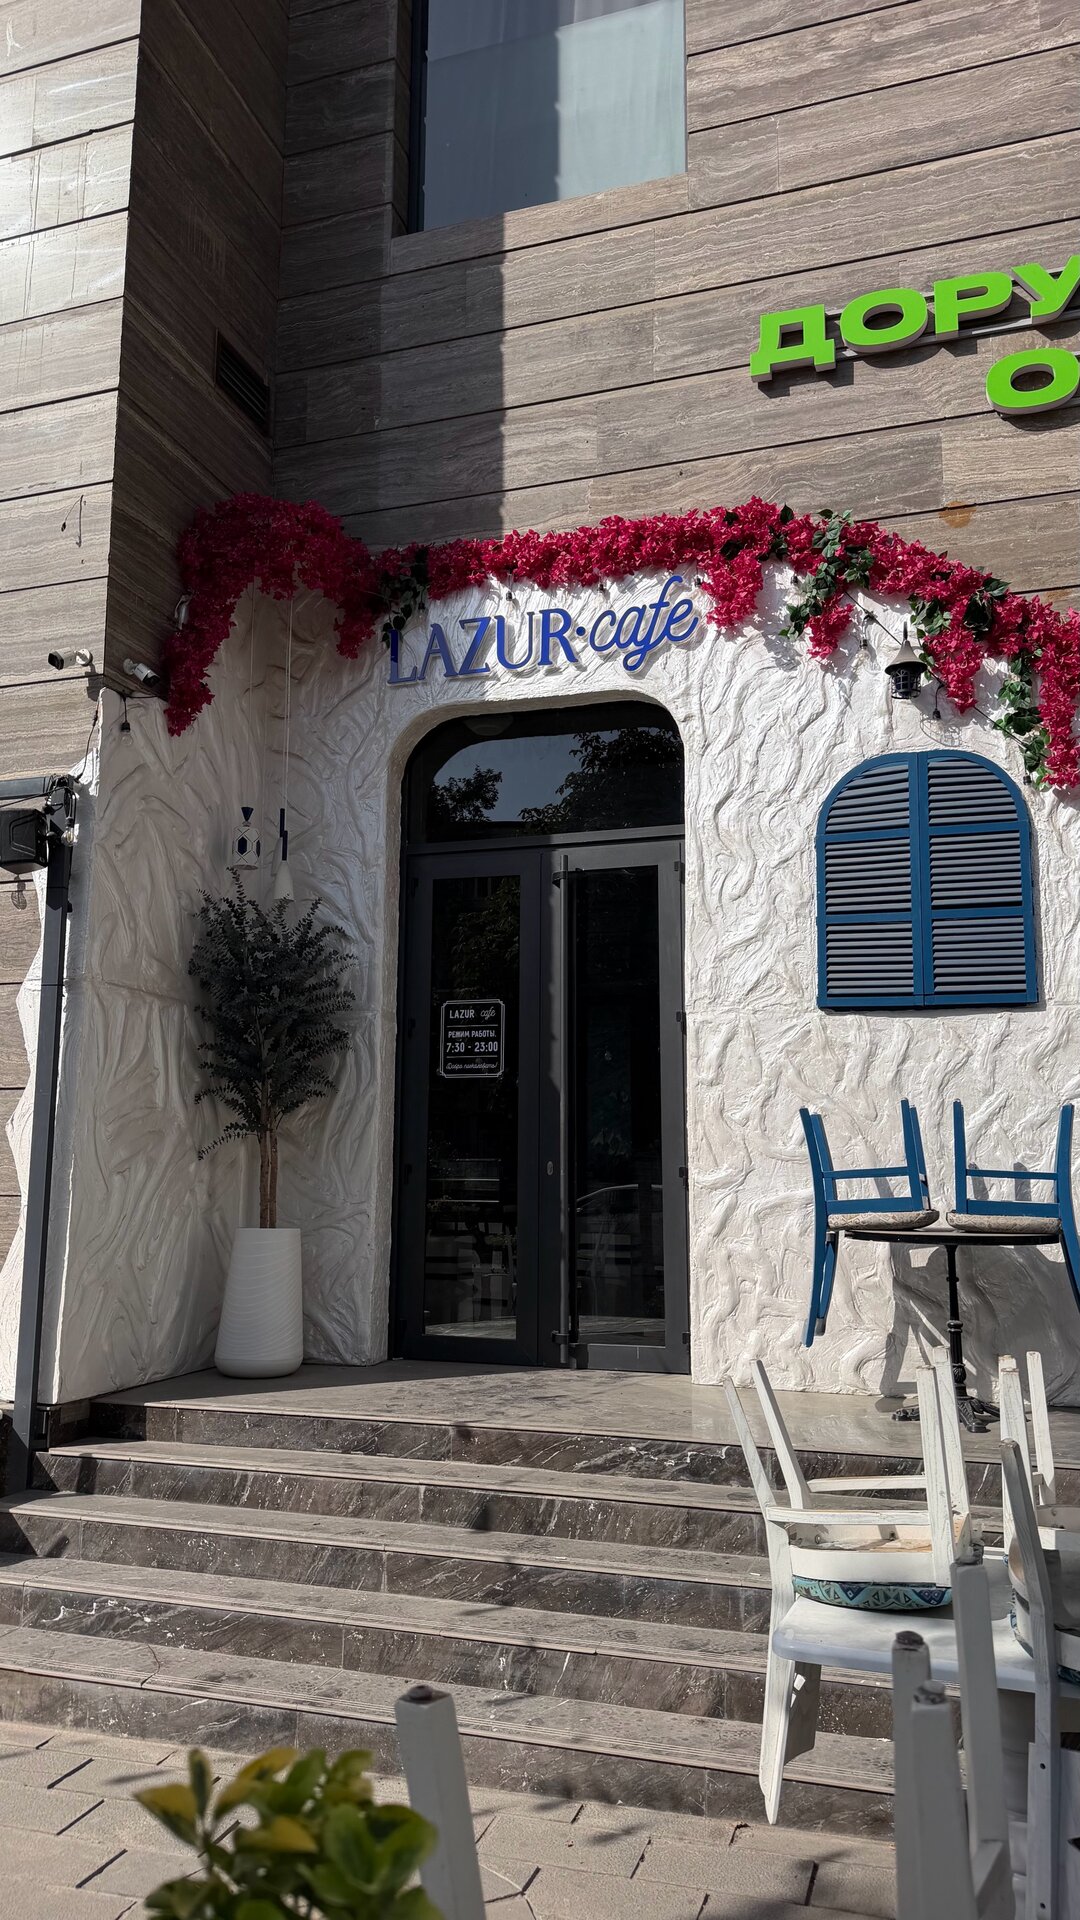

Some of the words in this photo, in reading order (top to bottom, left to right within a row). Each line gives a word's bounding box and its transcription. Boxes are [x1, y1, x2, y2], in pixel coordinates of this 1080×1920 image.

[750, 256, 1080, 380] ДОРУ
[449, 1009, 475, 1019] LAZUR
[480, 1006, 496, 1020] cafe
[448, 1030, 470, 1038] РЕЖИМ
[446, 1042, 465, 1052] 7:30
[474, 1041, 498, 1052] 23:00
